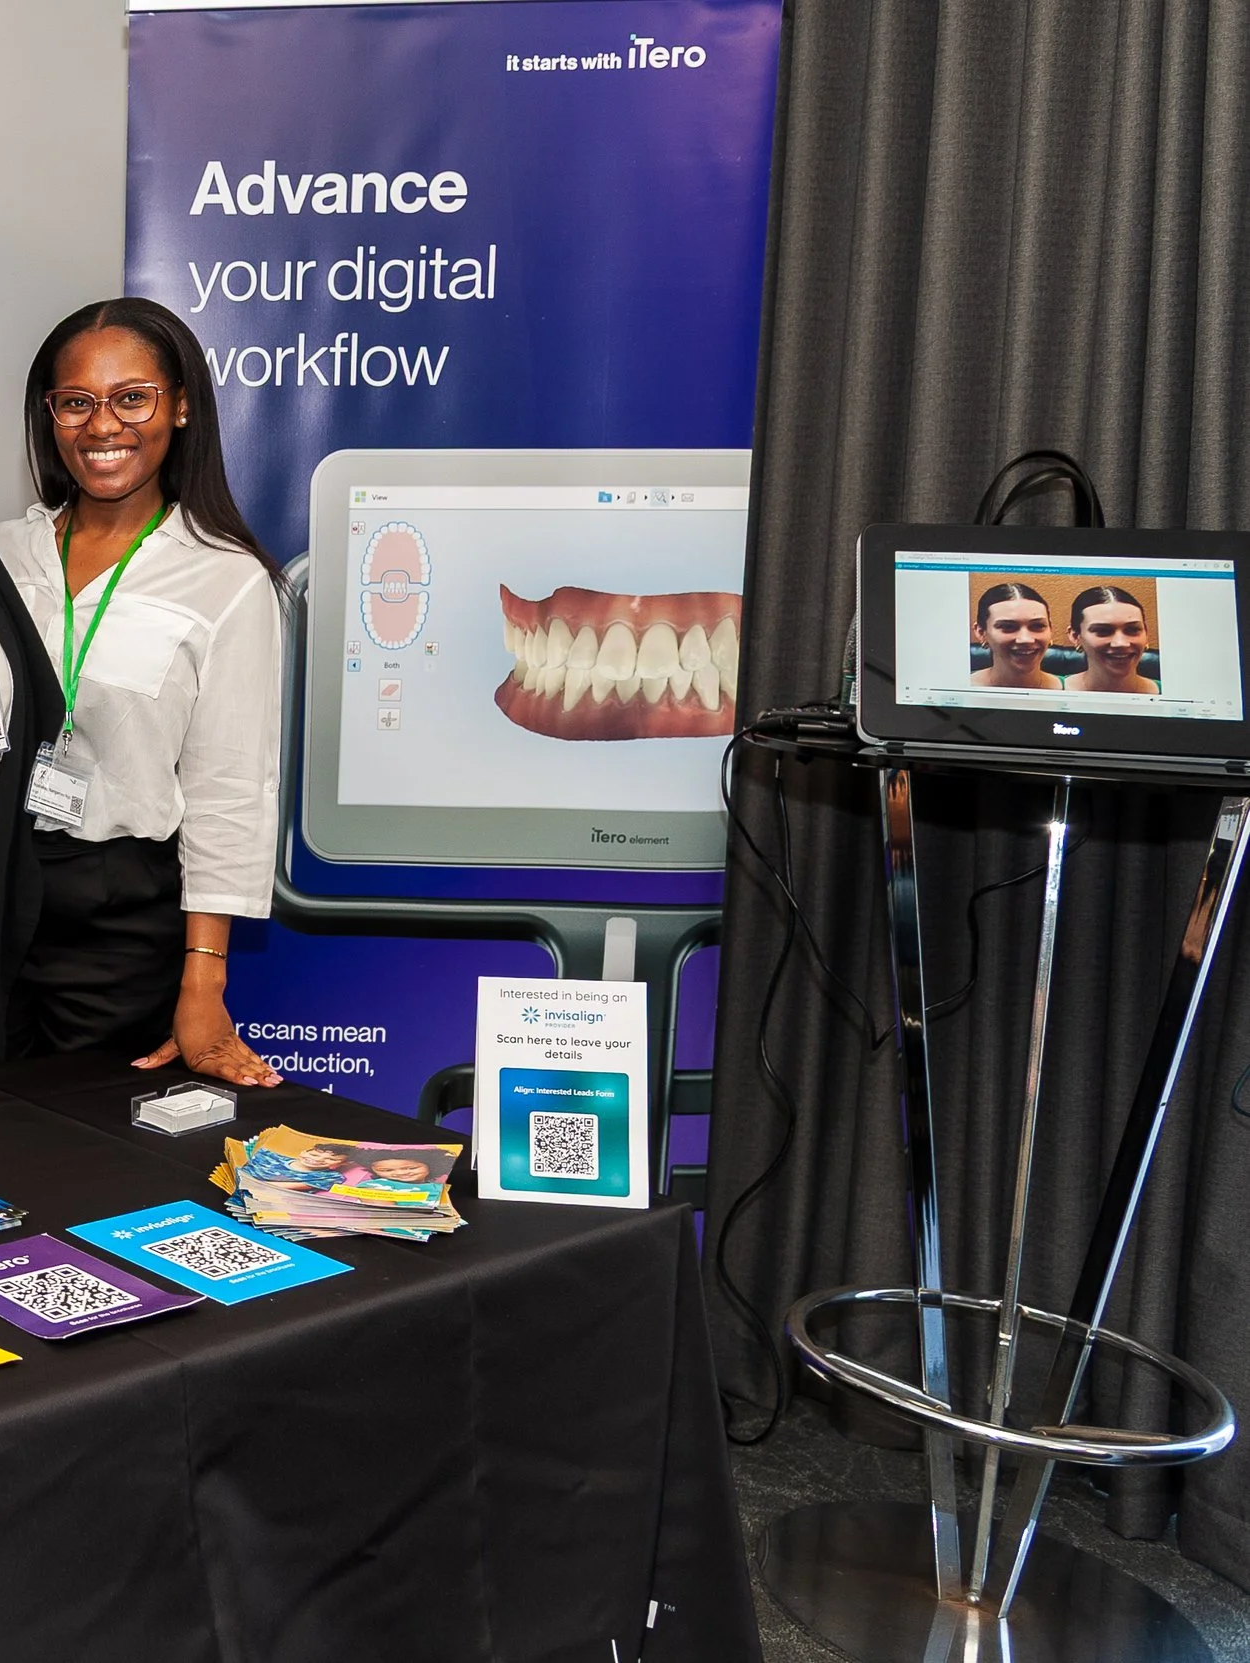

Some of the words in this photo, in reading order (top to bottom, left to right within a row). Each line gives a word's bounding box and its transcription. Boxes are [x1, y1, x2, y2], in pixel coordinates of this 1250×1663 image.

[506, 55, 519, 71] it
[522, 54, 578, 71] starts
[581, 53, 622, 70] with
[628, 33, 707, 69] iTero
[189, 160, 468, 215] Advance
[188, 257, 315, 313] your
[327, 244, 497, 313] digital
[591, 827, 627, 844] iTero
[629, 835, 670, 845] element
[500, 988, 558, 1000] Interested
[561, 991, 572, 1001] in
[575, 991, 609, 1004] being
[612, 994, 628, 1003] an
[545, 1009, 604, 1024] invisalign
[248, 1023, 317, 1042] scans
[322, 1025, 387, 1043] mean
[496, 1034, 524, 1045] Scan
[527, 1035, 552, 1046] here
[556, 1037, 568, 1046] to
[571, 1037, 602, 1048] leave
[605, 1039, 632, 1050] your
[545, 1050, 583, 1060] details
[261, 1052, 375, 1077] roduction,
[514, 1086, 535, 1095] Align:
[536, 1087, 572, 1096] Interested
[573, 1089, 594, 1098] Leads
[596, 1090, 615, 1098] Form
[131, 1214, 195, 1233] invisalign
